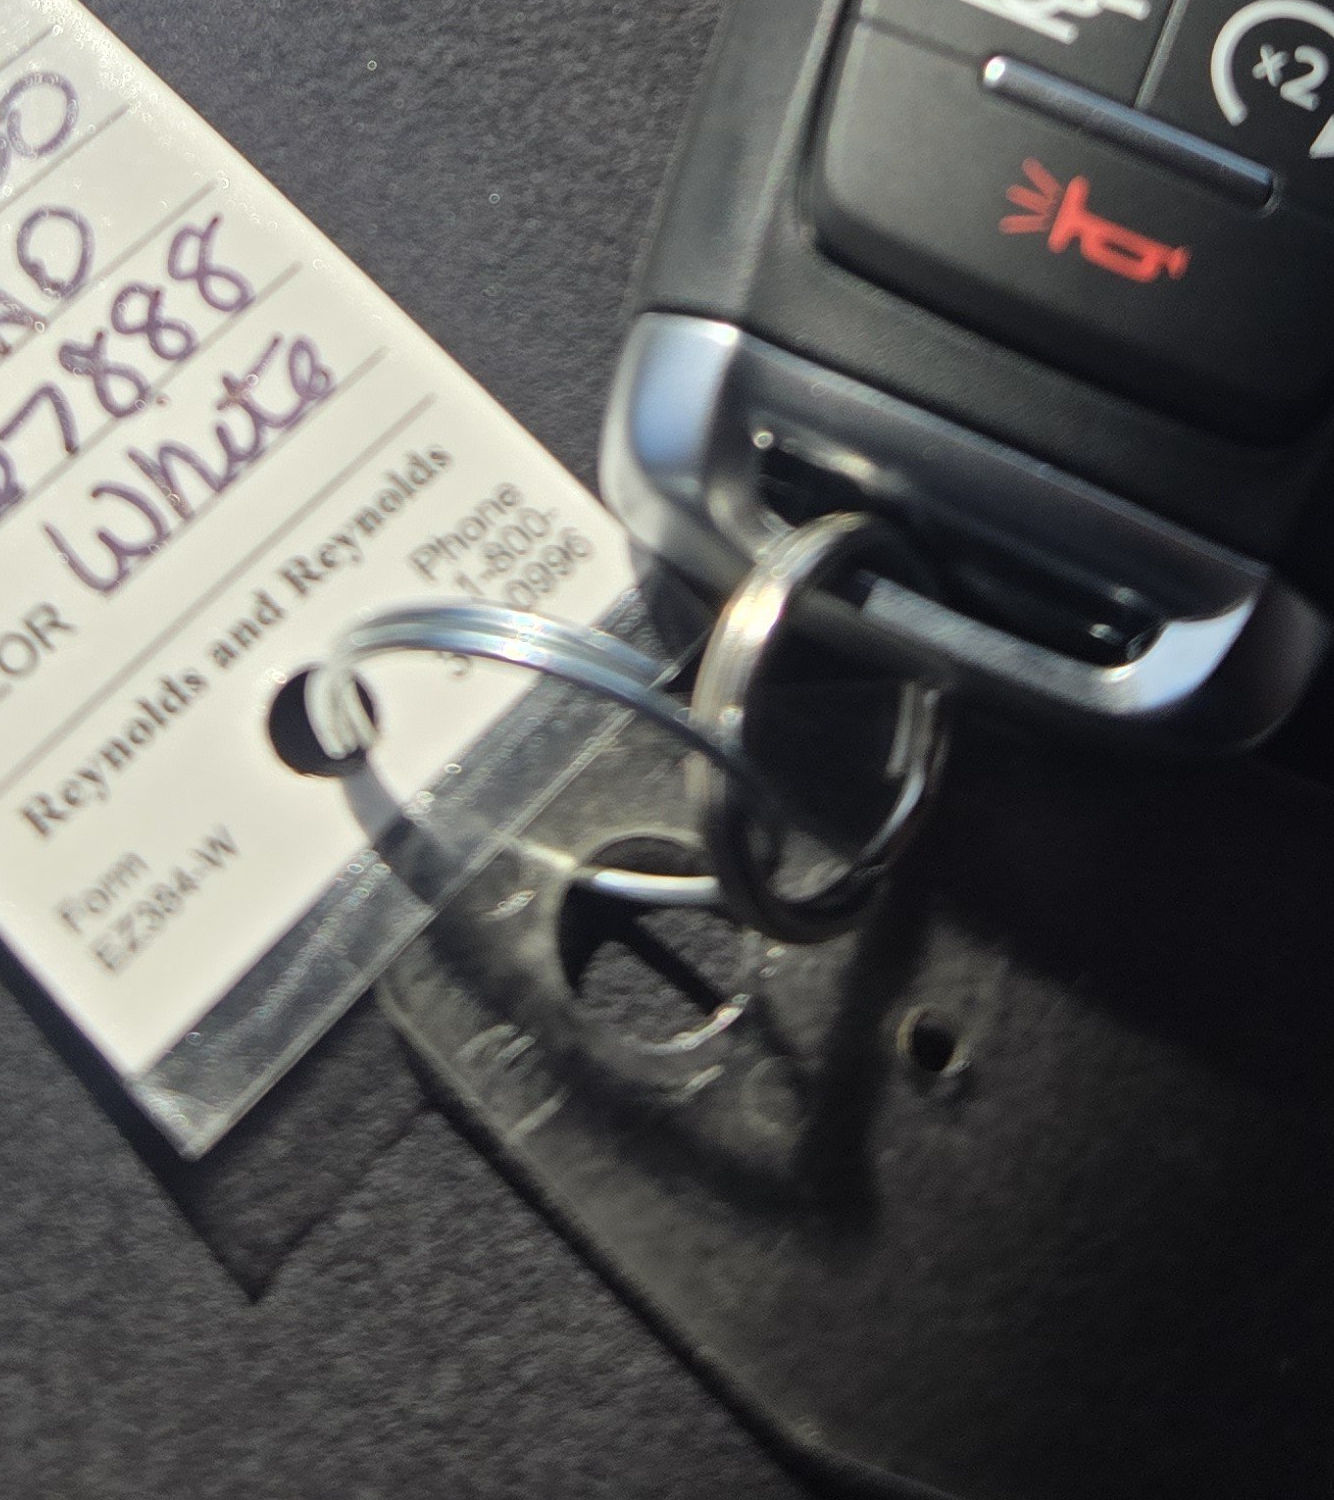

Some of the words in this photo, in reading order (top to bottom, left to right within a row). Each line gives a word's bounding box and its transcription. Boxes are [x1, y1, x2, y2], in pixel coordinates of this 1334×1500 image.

[42, 334, 337, 597] White
[408, 479, 525, 582] Phone
[18, 663, 208, 840] Reynolds
[209, 588, 288, 670] and
[279, 439, 456, 596] Reynolds
[53, 849, 150, 934] Form
